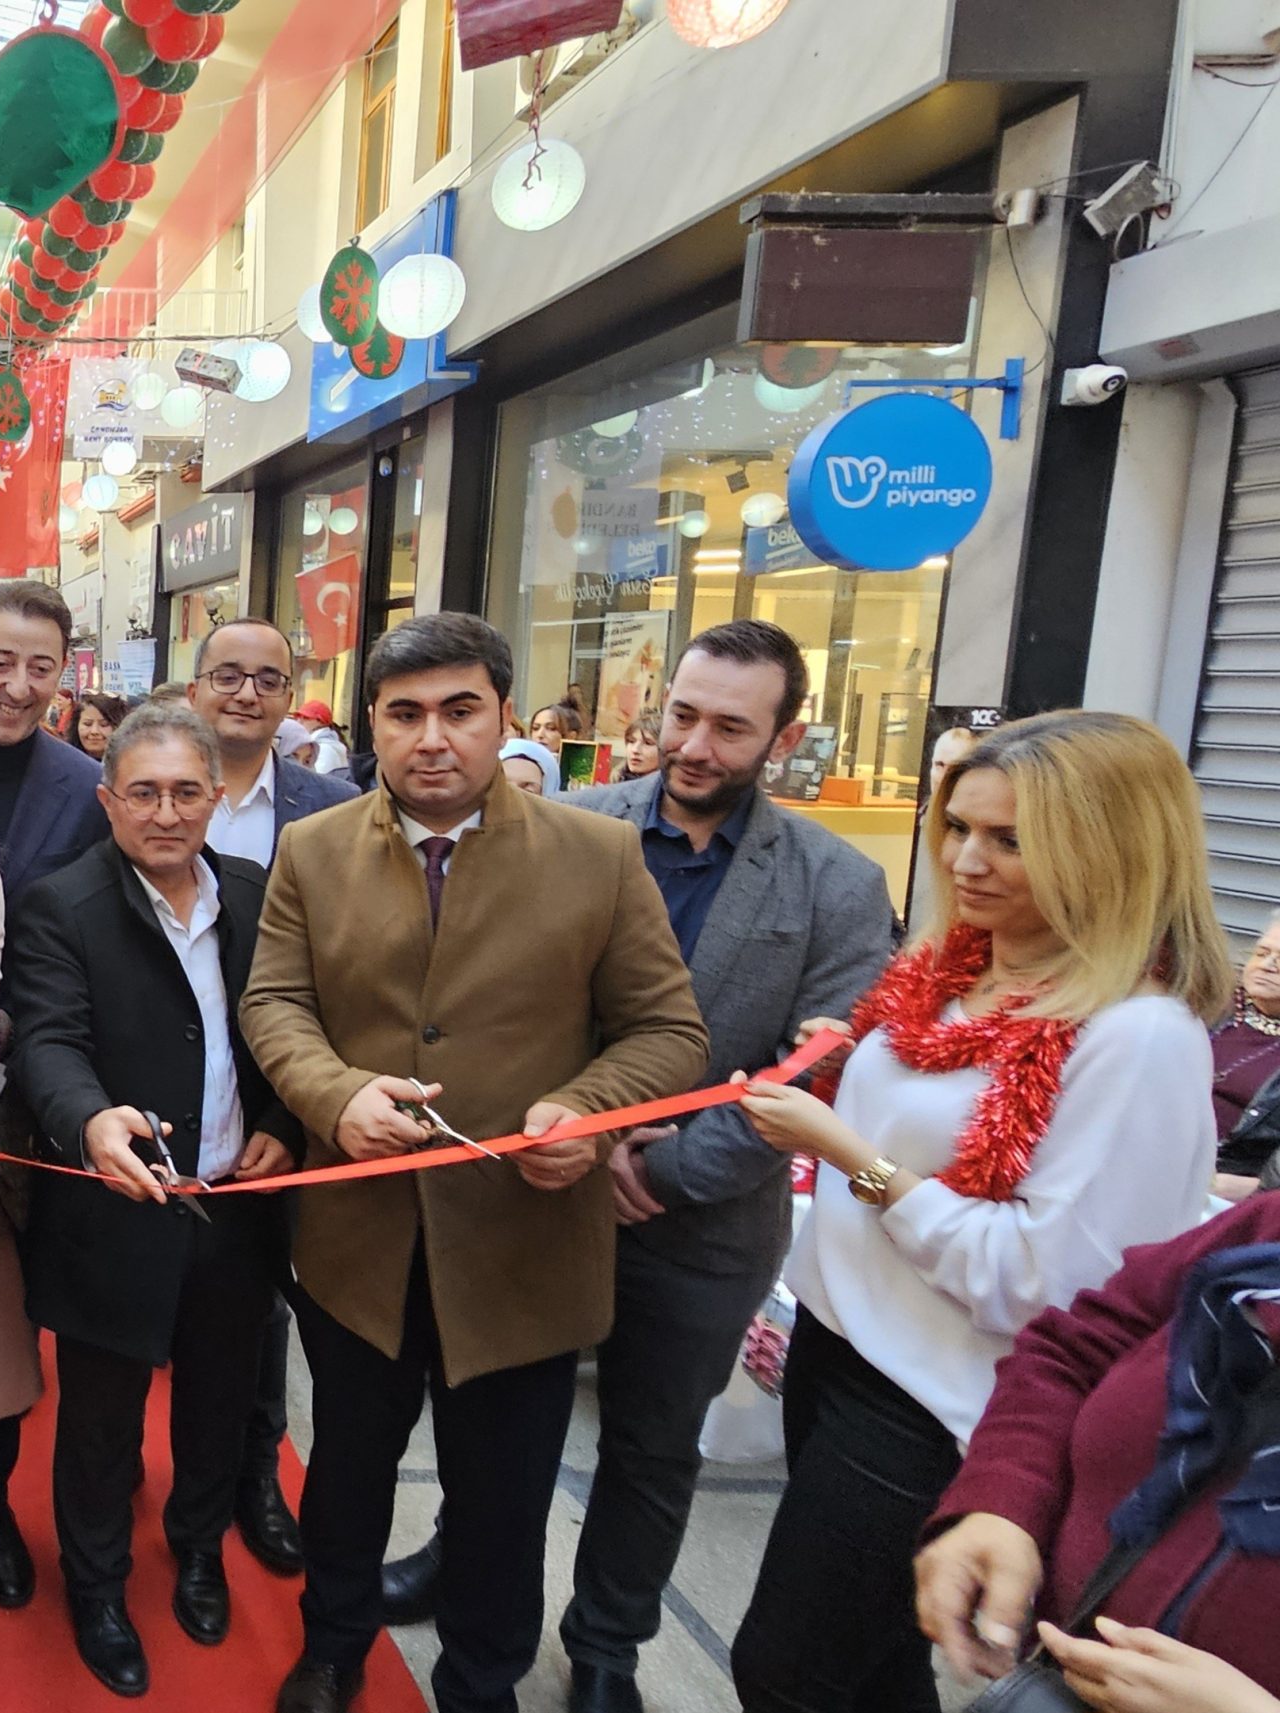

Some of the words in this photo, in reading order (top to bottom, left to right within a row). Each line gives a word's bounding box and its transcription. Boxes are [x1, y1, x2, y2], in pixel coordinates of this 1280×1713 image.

[889, 465, 936, 484] milli
[886, 485, 976, 507] piyango
[768, 524, 801, 547] bek
